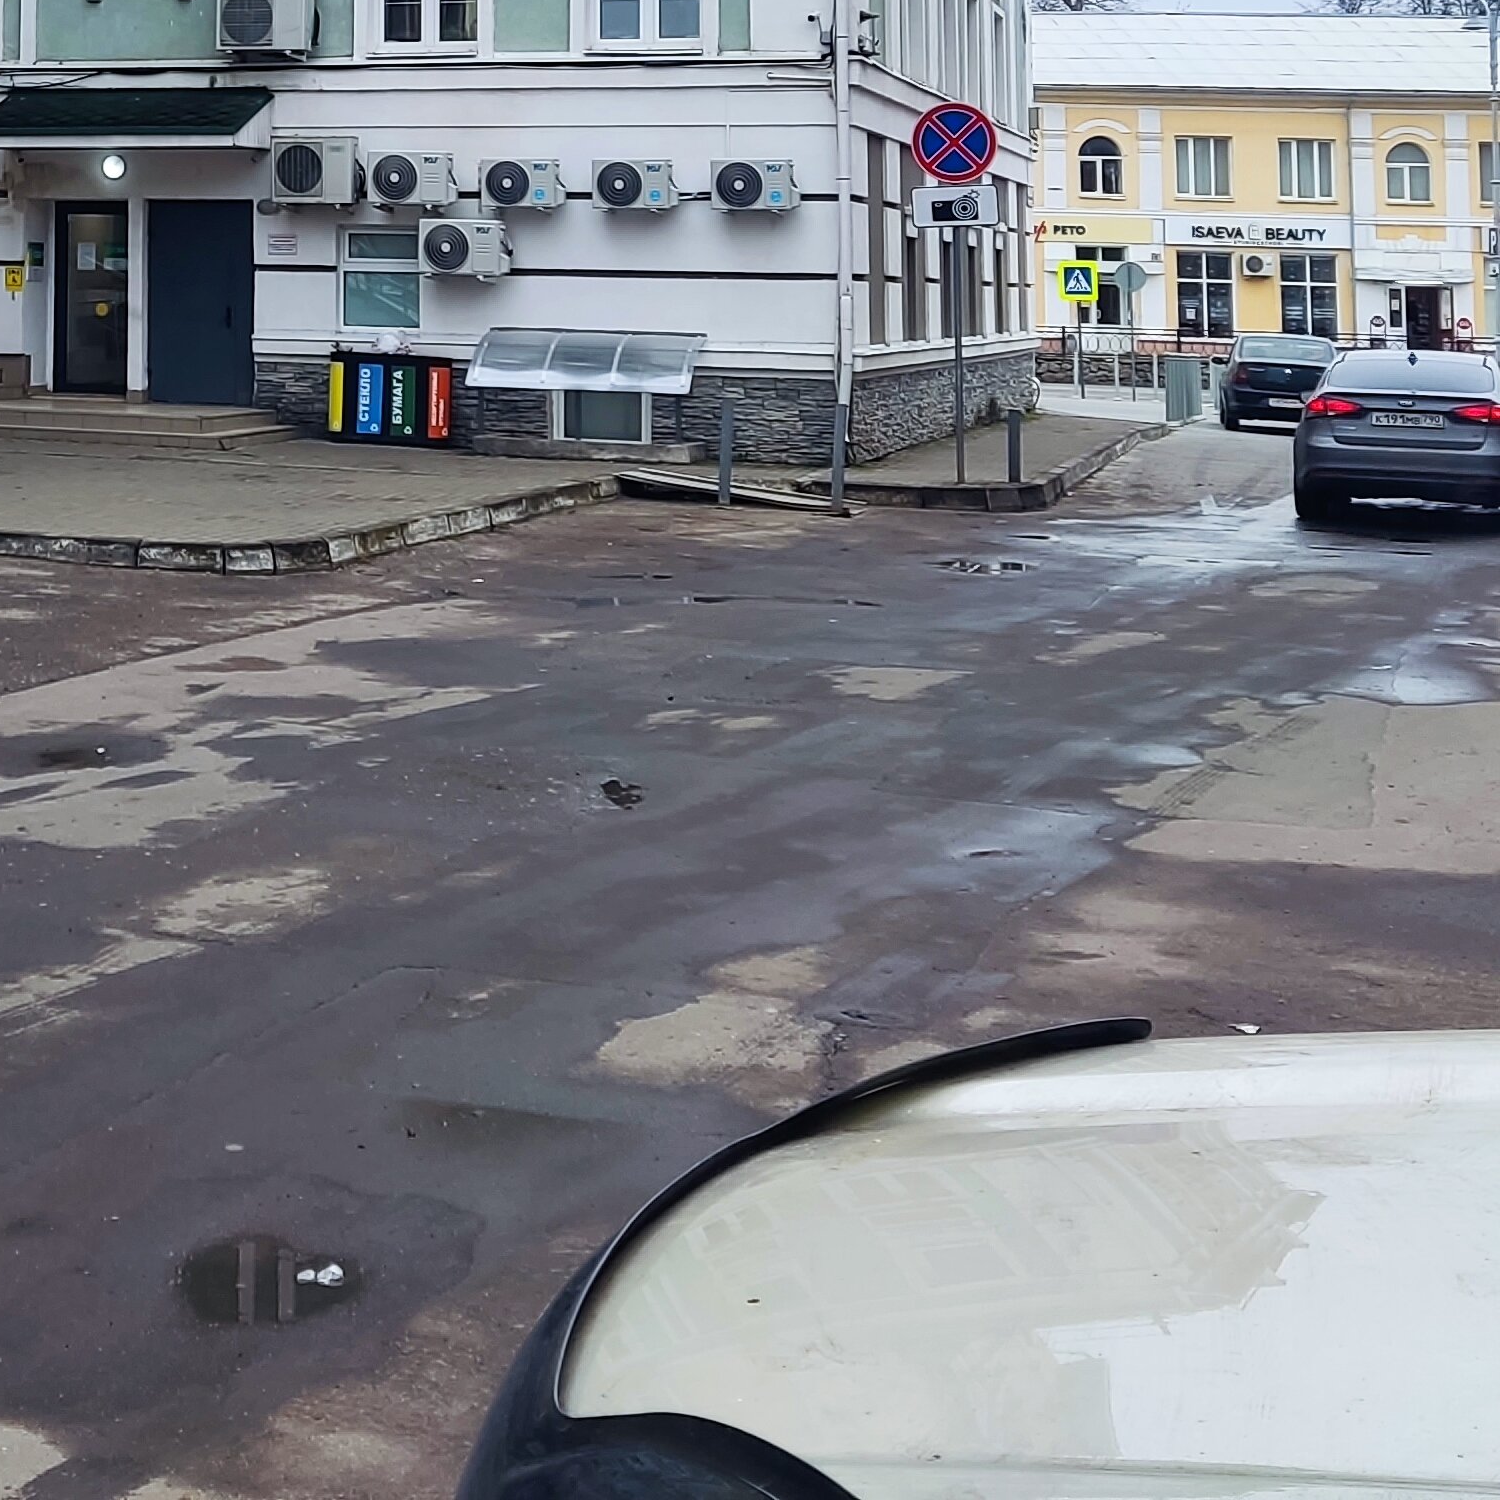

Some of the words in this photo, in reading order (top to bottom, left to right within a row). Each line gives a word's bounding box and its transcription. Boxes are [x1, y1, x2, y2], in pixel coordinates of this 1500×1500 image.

[1191, 225, 1245, 240] ISAEVA
[1265, 227, 1327, 242] BEAUTY
[359, 368, 371, 422] СТЕКЛО
[392, 370, 404, 425] БУМАГА
